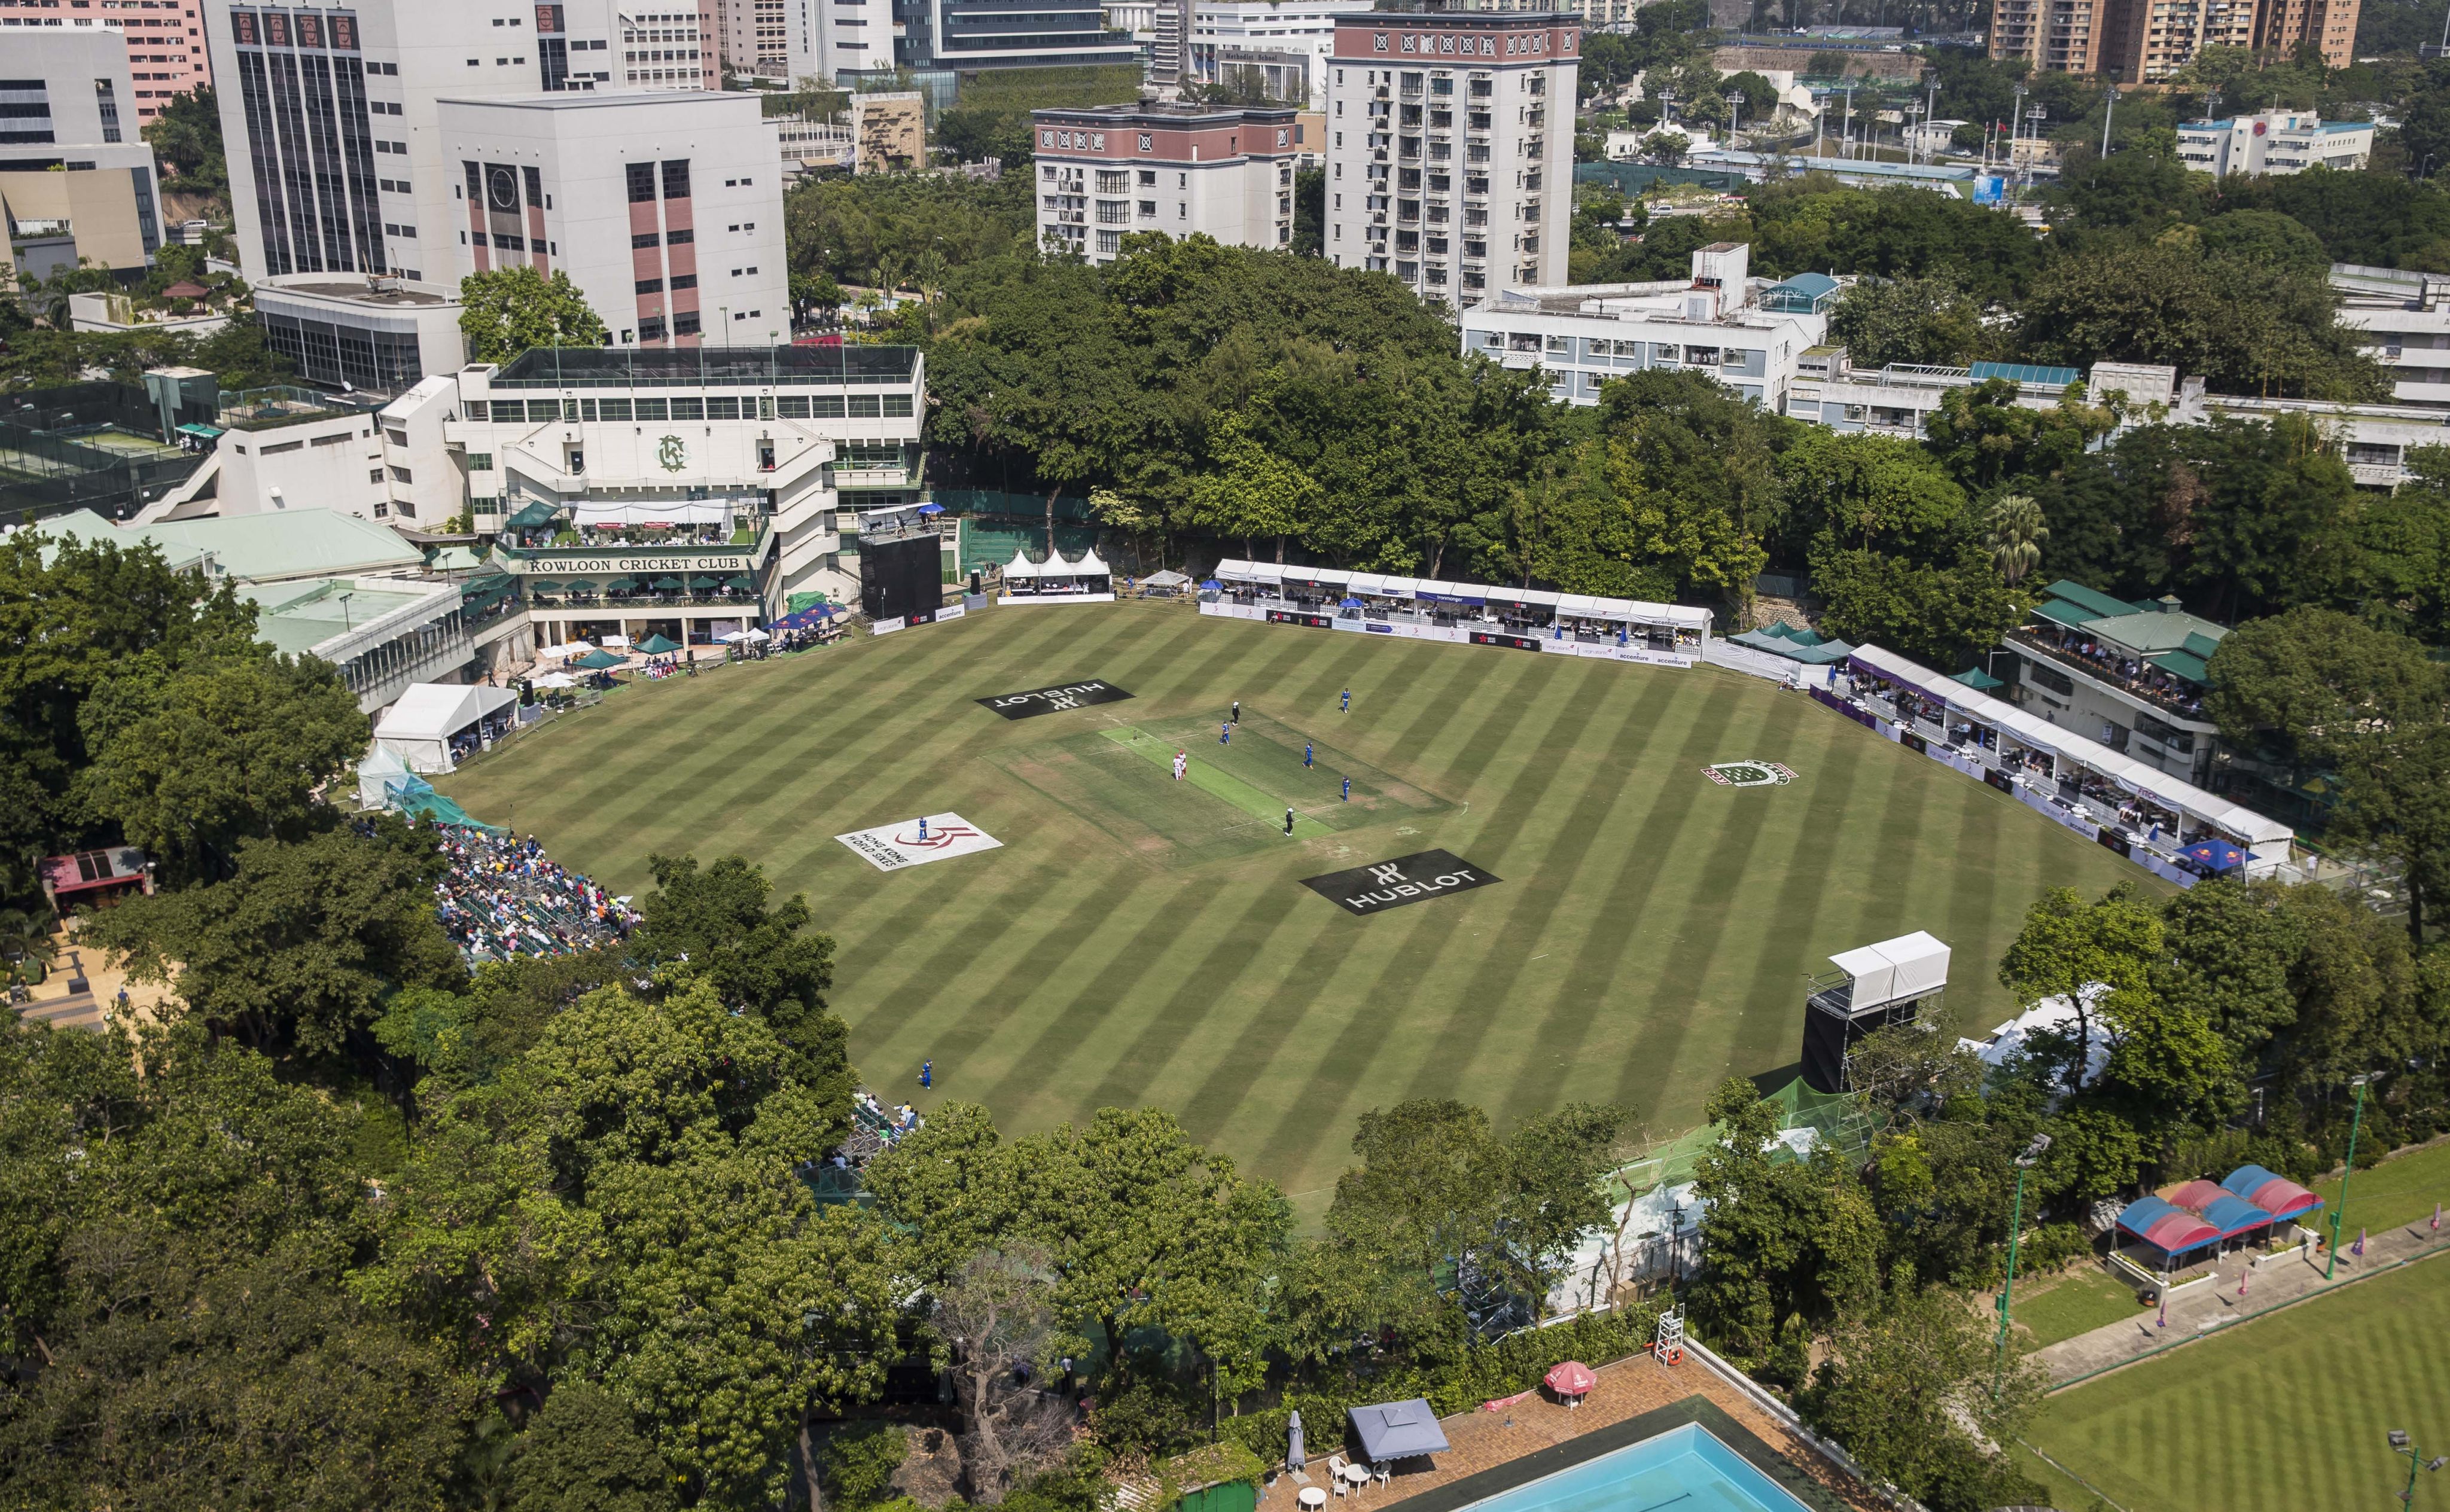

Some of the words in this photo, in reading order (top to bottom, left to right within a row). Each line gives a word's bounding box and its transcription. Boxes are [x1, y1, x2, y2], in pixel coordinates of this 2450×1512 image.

[529, 560, 611, 572] KOWLOON
[619, 559, 691, 570] CRICKET
[697, 558, 739, 569] CLUB
[939, 610, 961, 619] accenture
[994, 683, 1105, 708] HUBLOT
[2069, 822, 2094, 837] accenture
[846, 835, 875, 852] WORLD
[871, 852, 897, 867] SIXES
[860, 833, 886, 848] HONG
[882, 847, 908, 863] KONG
[1345, 870, 1476, 908] HUBLOT
